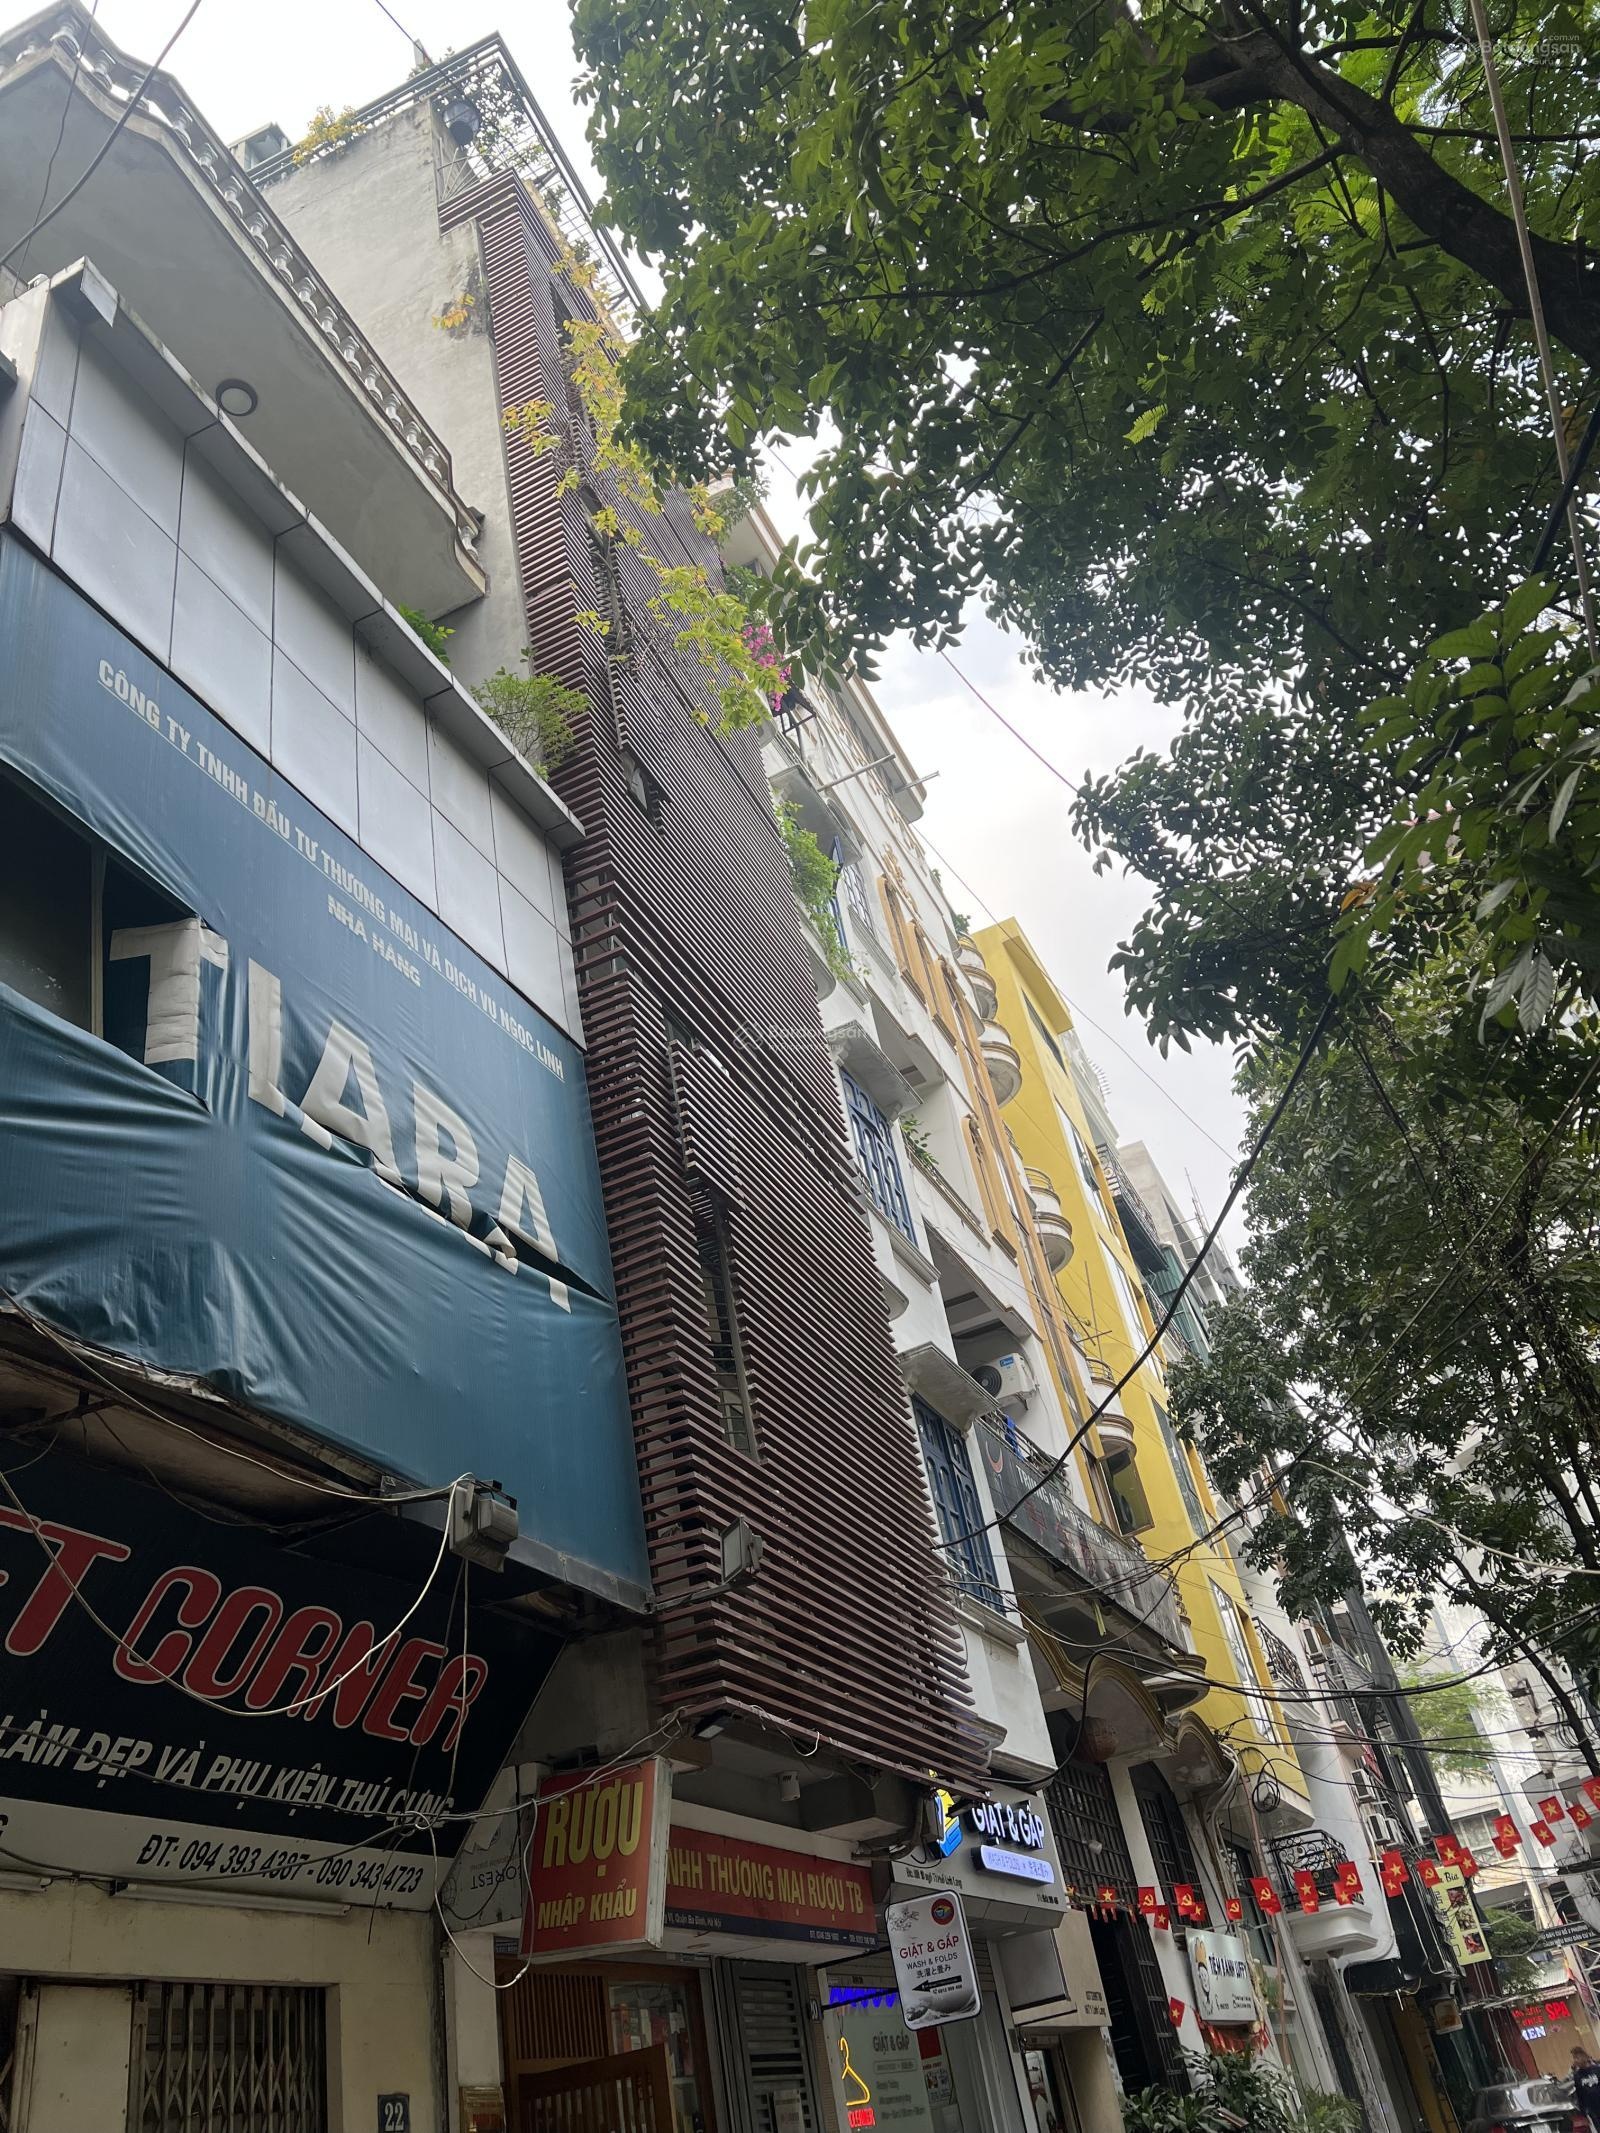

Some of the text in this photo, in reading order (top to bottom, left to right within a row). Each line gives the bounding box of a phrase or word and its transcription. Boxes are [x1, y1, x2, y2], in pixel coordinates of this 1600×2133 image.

[98, 659, 161, 730] CÔNG
[196, 741, 248, 805] TNHH
[253, 790, 290, 839] ĐẦU
[294, 825, 319, 861] TƯ
[320, 849, 386, 924] THƯƠNG
[390, 909, 419, 951] MẠI
[423, 936, 441, 972] VÀ
[537, 1038, 565, 1080] LINH
[108, 916, 573, 1313] TIARA
[112, 1566, 489, 1753] CORNER
[0, 1709, 81, 1768] LÀM
[73, 1731, 154, 1789] ĐẸP
[153, 1738, 207, 1787] VÀ
[203, 1756, 273, 1810] PHỤ
[267, 1762, 339, 1817] KIỆN
[334, 1776, 394, 1816] THÚ
[541, 1779, 643, 1877] RƯỢU
[1006, 1803, 1021, 1842] &
[136, 1833, 180, 1868] ĐT:
[178, 1840, 217, 1871] 094
[219, 1843, 258, 1875] 393
[310, 1857, 349, 1887] 090
[349, 1860, 382, 1889] 343
[381, 1864, 424, 1894] 4723
[706, 1854, 775, 1902] THƯƠNG
[776, 1867, 806, 1917] MẠI
[806, 1871, 846, 1921] RƯỢU
[845, 1879, 865, 1914] TB
[1443, 1871, 1459, 1883] Bia
[536, 1875, 638, 1931] NHẬP KHẨU
[899, 1931, 960, 1960] GIẶT & GẤP
[906, 1957, 927, 1971] WASH
[934, 1952, 959, 1966] FOLDS
[1545, 2000, 1571, 2022] SPA
[384, 2102, 405, 2132] 22
